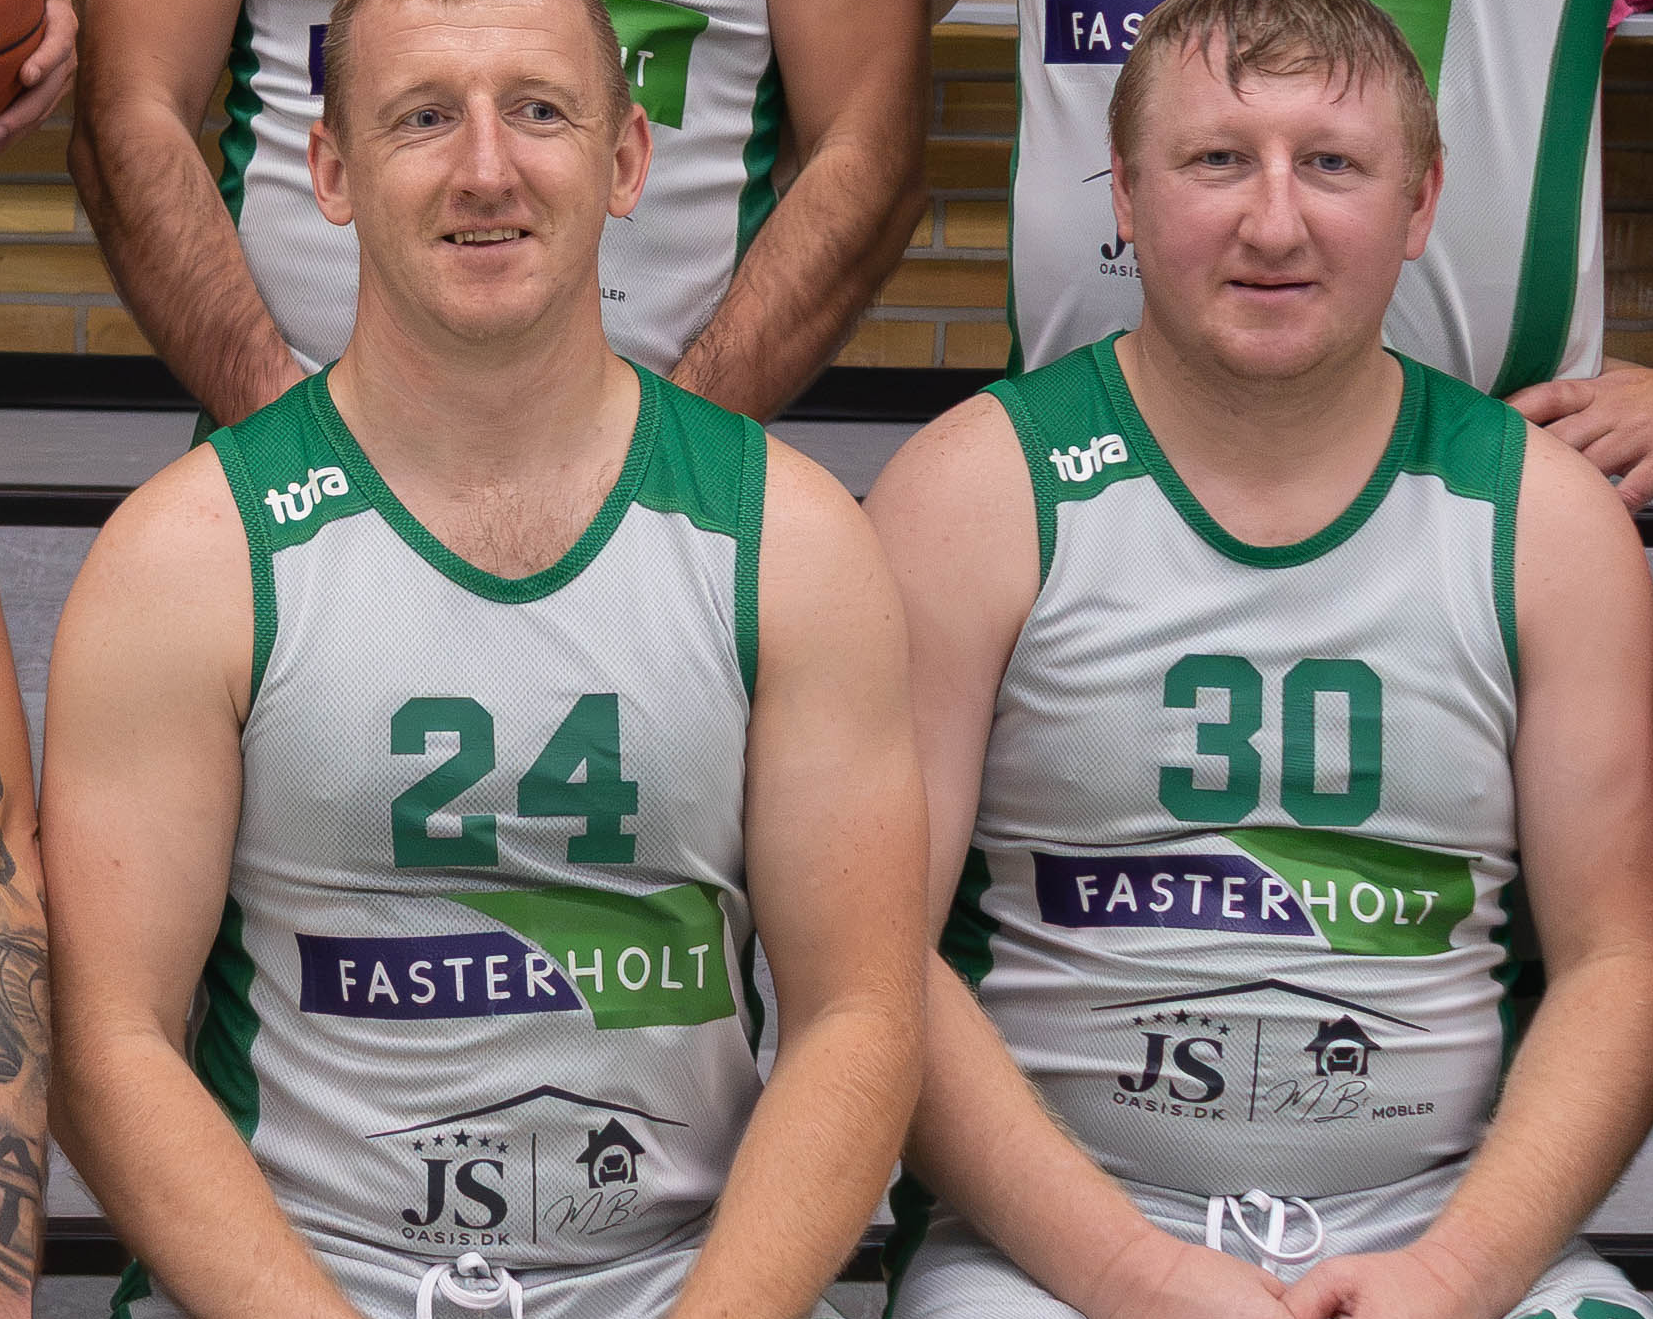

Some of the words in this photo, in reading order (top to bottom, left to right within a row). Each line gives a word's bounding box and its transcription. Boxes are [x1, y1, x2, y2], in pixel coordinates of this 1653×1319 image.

[602, 287, 626, 303] LER
[1157, 653, 1384, 827] 30
[390, 692, 639, 869] 24
[1075, 871, 1441, 929] FASTERHOLT
[339, 941, 712, 1006] FASTERHOLT
[1117, 1030, 1231, 1105] JS
[1112, 1090, 1227, 1121] OASIS.DK
[401, 1157, 509, 1231] JS
[402, 1226, 511, 1247] OASIS.DK
